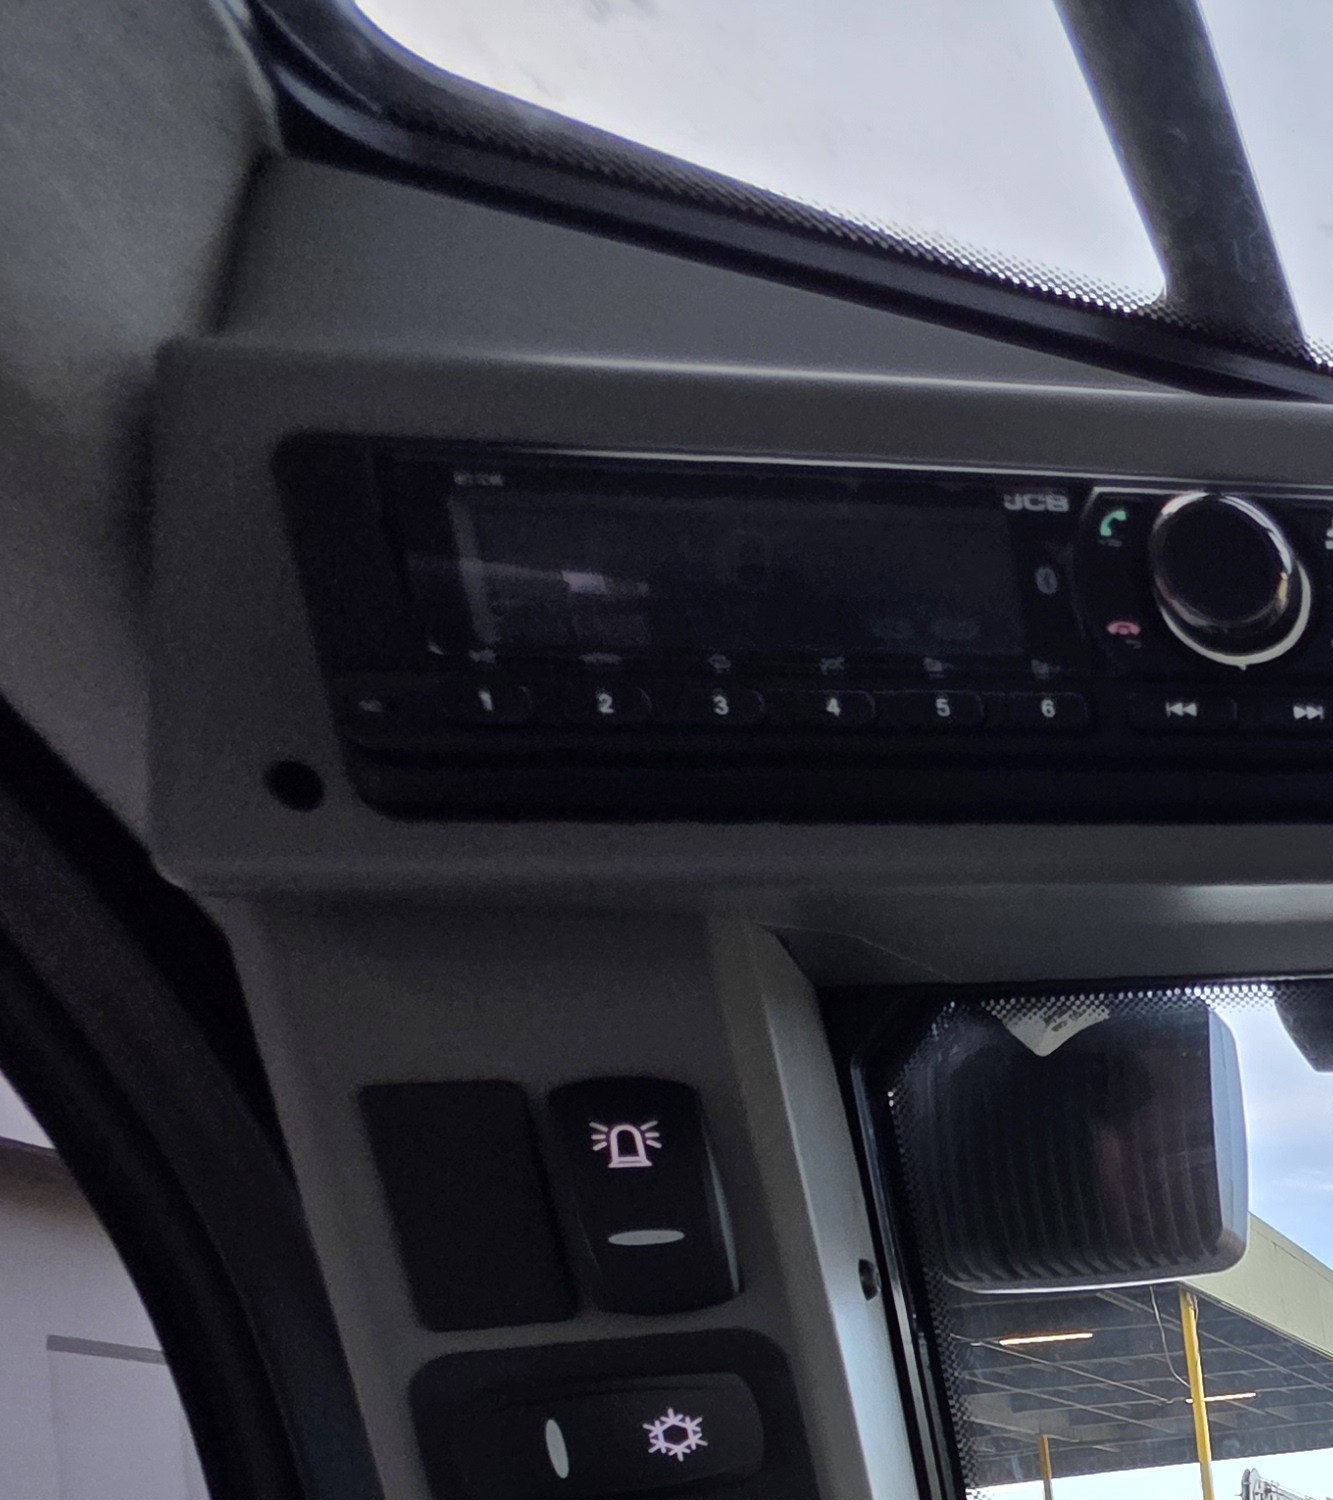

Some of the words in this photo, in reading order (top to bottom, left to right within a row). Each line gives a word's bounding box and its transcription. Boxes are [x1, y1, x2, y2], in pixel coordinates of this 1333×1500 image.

[1003, 492, 1070, 513] JCB
[477, 690, 494, 713] 1
[596, 692, 615, 715] 2
[712, 694, 730, 717] 3
[825, 696, 842, 718] 4
[935, 697, 952, 718] 5
[1040, 698, 1056, 719] 6
